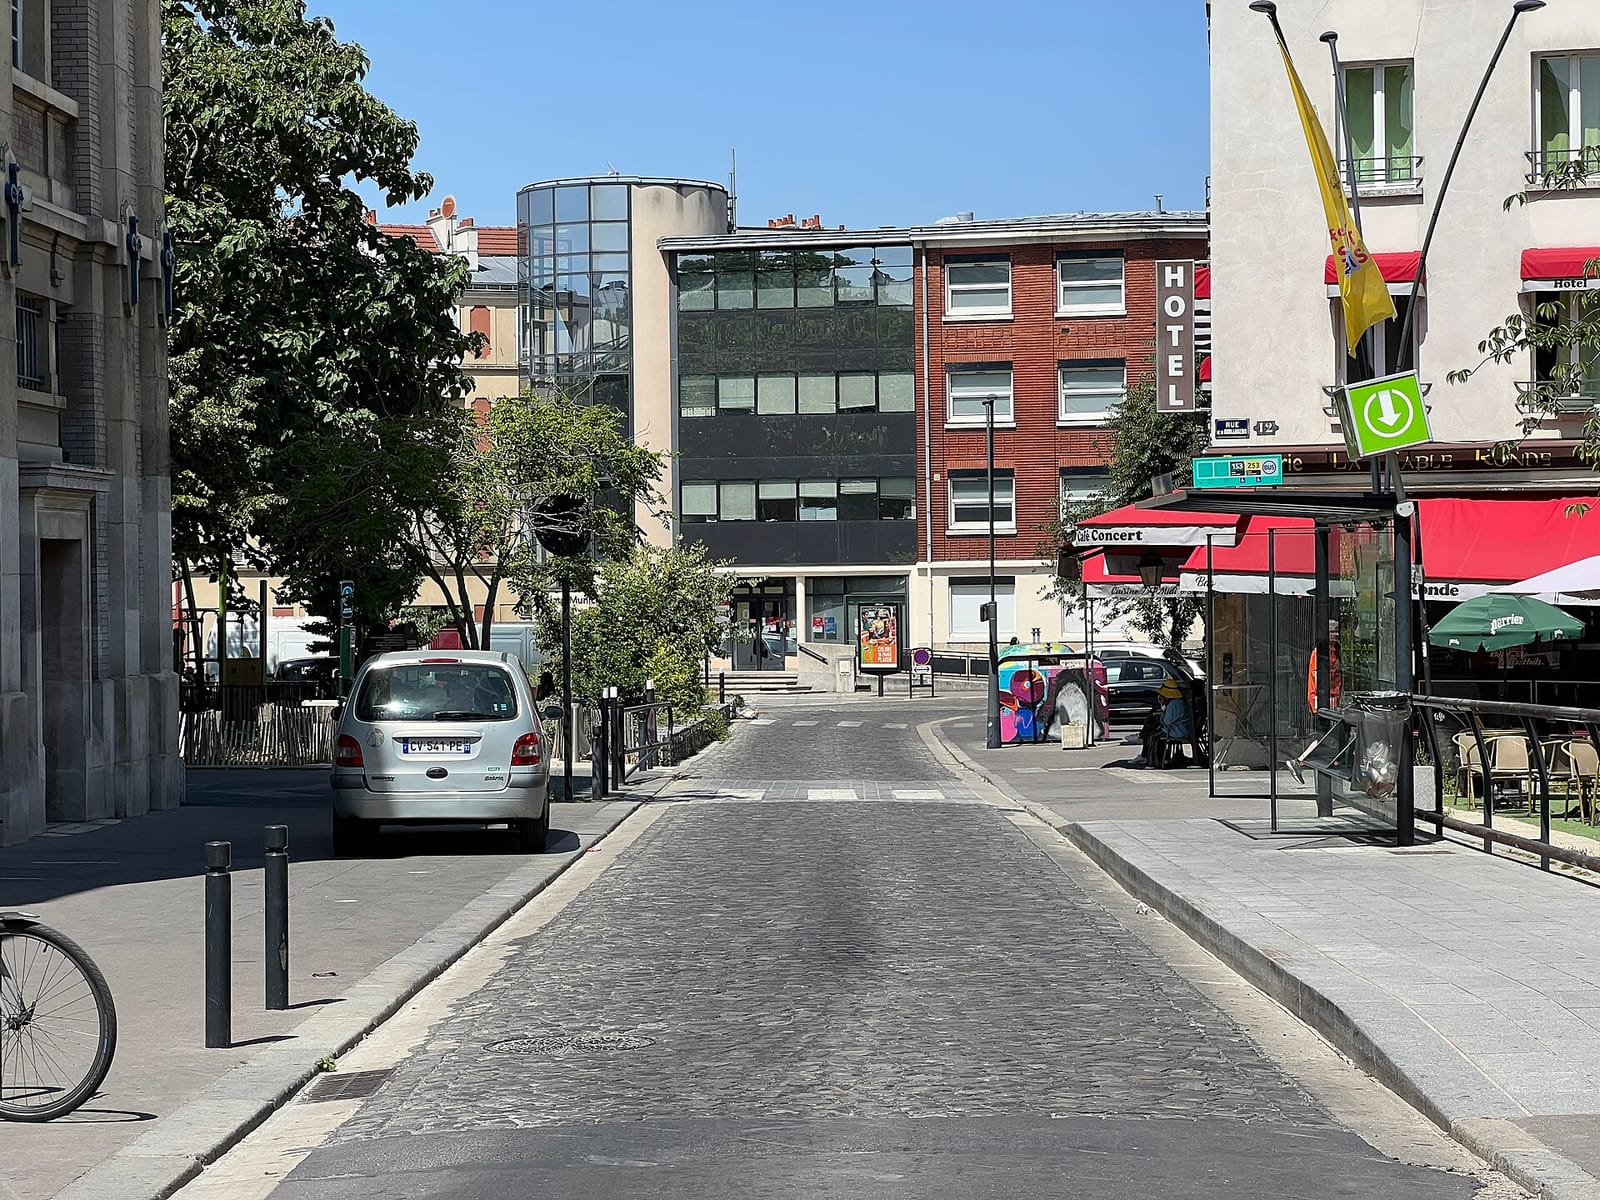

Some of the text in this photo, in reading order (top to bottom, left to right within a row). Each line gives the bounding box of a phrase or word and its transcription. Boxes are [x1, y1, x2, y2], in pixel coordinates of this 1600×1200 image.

[1164, 265, 1185, 406] HOTEL
[1258, 422, 1274, 433] 12
[1400, 454, 1453, 471] ABLE
[1077, 528, 1143, 542] Café Concert
